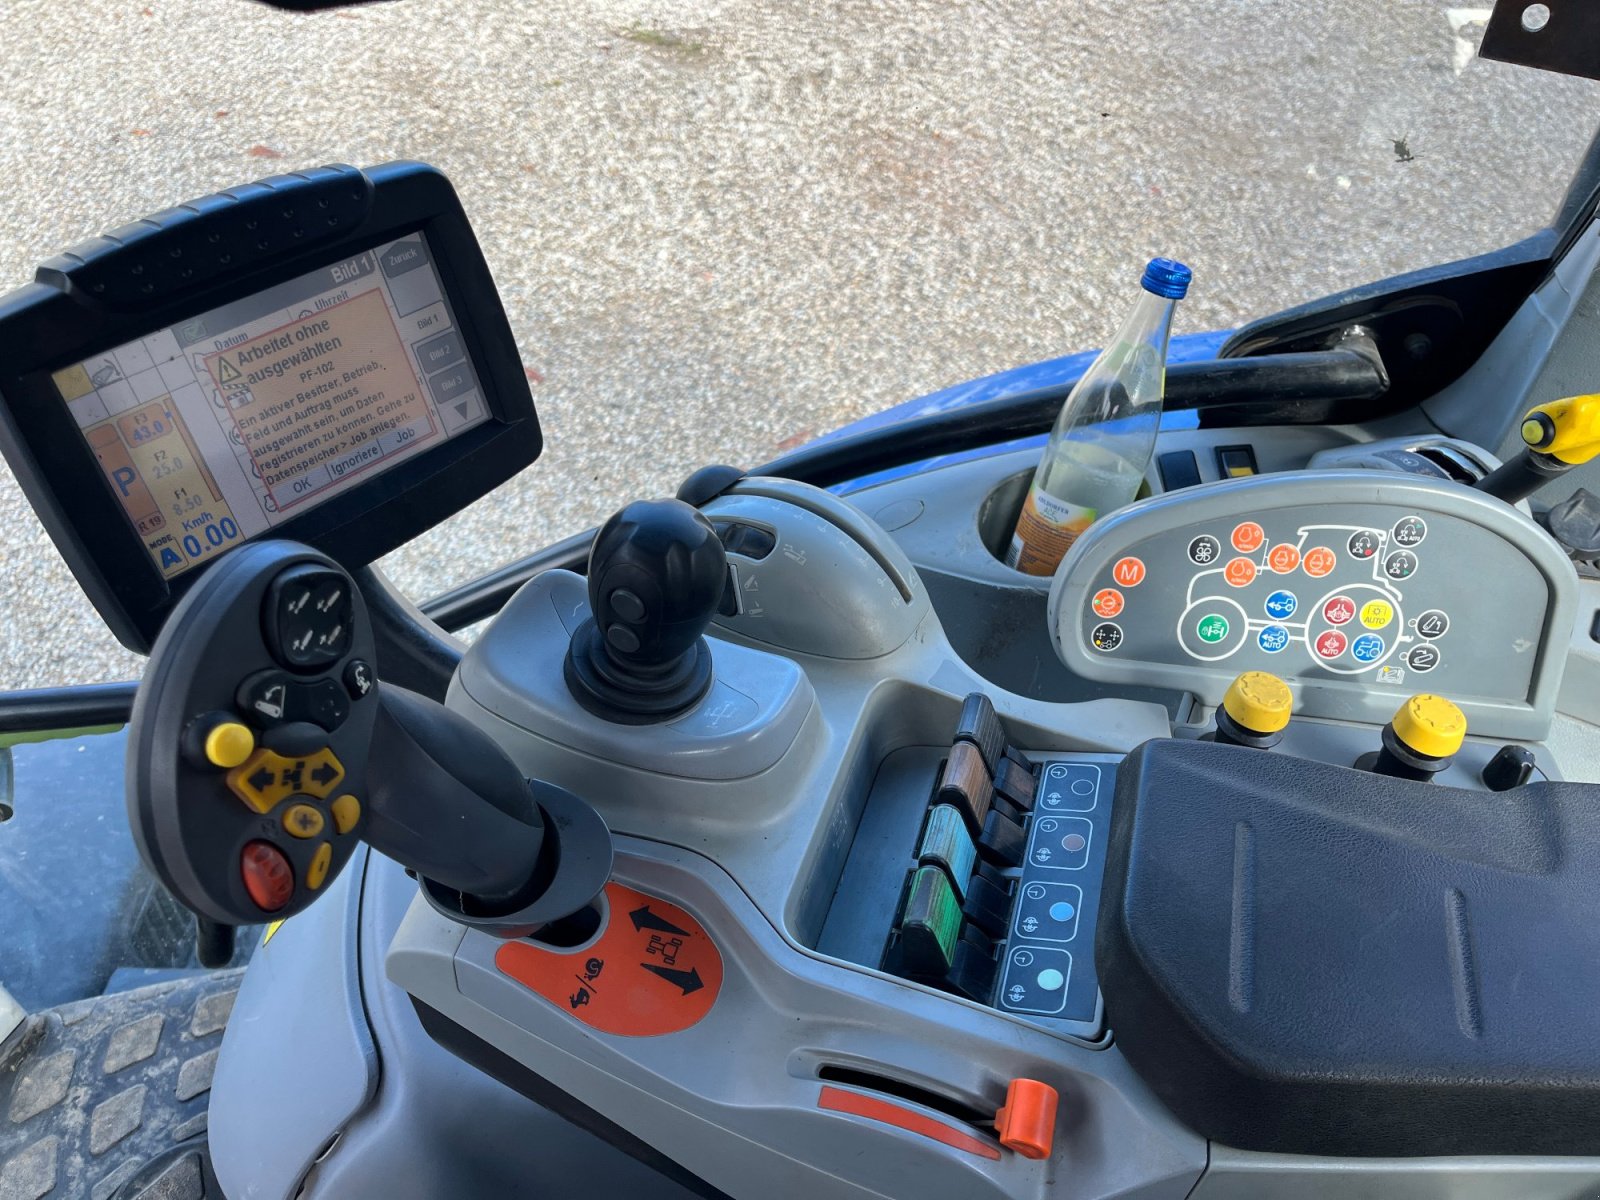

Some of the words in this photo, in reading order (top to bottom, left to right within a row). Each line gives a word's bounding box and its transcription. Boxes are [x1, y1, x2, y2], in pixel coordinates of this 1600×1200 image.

[330, 260, 360, 284] Bild
[361, 256, 372, 271] 1
[314, 290, 350, 310] Uhrzeit
[416, 316, 433, 330] Bild
[213, 332, 249, 351] Datum
[237, 332, 295, 367] Arbeitet
[295, 319, 331, 342] ohne
[247, 336, 343, 385] ausgewählten
[429, 348, 444, 361] Bild
[299, 361, 336, 383] PF-102
[238, 415, 257, 429] Ein
[258, 398, 295, 421] aktiver
[296, 379, 342, 404] Besitzer,
[342, 361, 383, 384] Betrieb,
[339, 405, 356, 418] um
[355, 391, 385, 410] Daten
[133, 412, 148, 425] F3
[245, 425, 271, 444] Feld
[272, 415, 293, 432] und
[294, 399, 333, 423] Auftrag
[332, 386, 360, 405] muss
[133, 420, 165, 442] 43.0
[260, 438, 322, 473] registrieren
[321, 431, 335, 442] zu
[376, 398, 402, 416] Gehe
[403, 392, 416, 403] zu
[153, 450, 167, 462] F2
[266, 445, 340, 486] Datenspeicher
[350, 430, 368, 446] Job
[369, 412, 411, 437] anlegen.
[293, 476, 312, 493] OK
[330, 445, 379, 476] Ignoriere
[396, 427, 415, 444] Job
[152, 457, 183, 480] 25.0
[112, 466, 137, 497] P
[174, 487, 188, 500] F1
[173, 494, 203, 516] 8.50
[138, 521, 149, 533] R
[182, 511, 213, 532] Km/h
[148, 534, 174, 549] MODE
[183, 516, 238, 558] 0.00
[160, 547, 183, 570] A
[1120, 564, 1139, 581] M
[1364, 616, 1386, 625] AUTO
[1262, 641, 1282, 650] AUTO
[1321, 648, 1339, 656] AUTO
